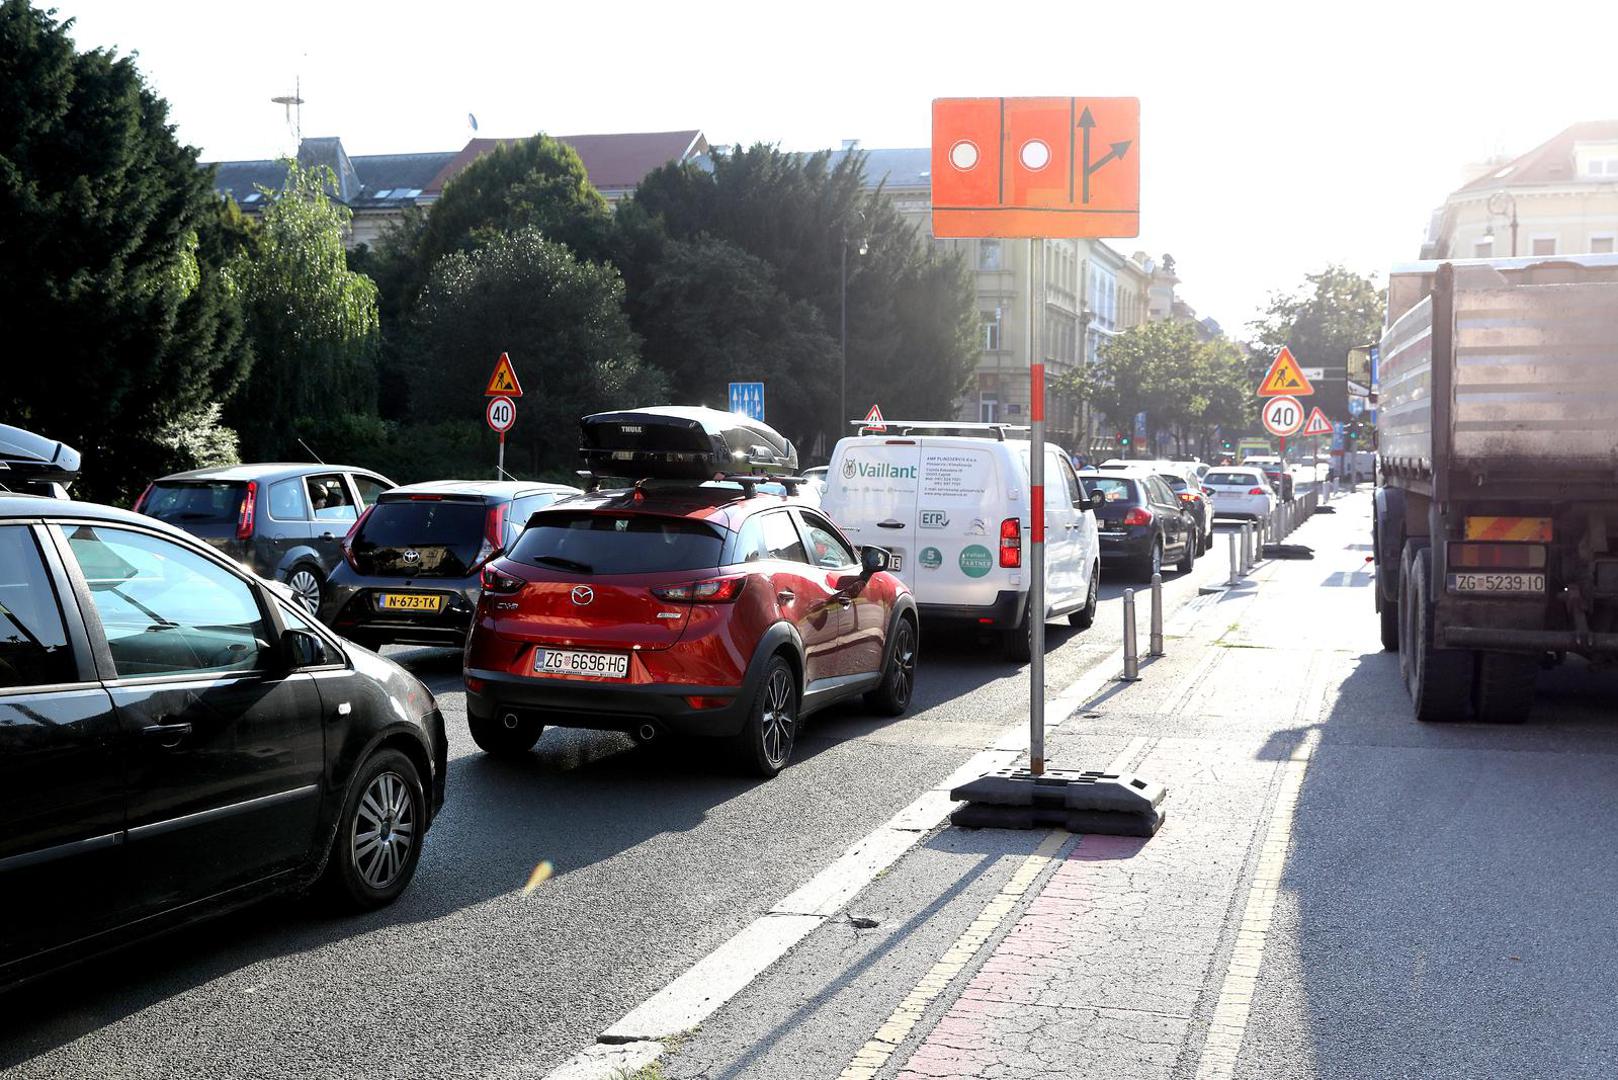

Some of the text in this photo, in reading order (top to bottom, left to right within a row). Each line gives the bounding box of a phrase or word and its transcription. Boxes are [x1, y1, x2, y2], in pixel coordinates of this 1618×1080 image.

[492, 405, 509, 423] 40
[1271, 407, 1294, 427] 40
[620, 425, 642, 433] THULE
[858, 462, 918, 479] Vaillant
[927, 550, 935, 560] 5
[1457, 575, 1476, 590] ZG
[389, 596, 435, 608] N-673-TK
[545, 652, 563, 668] ZG
